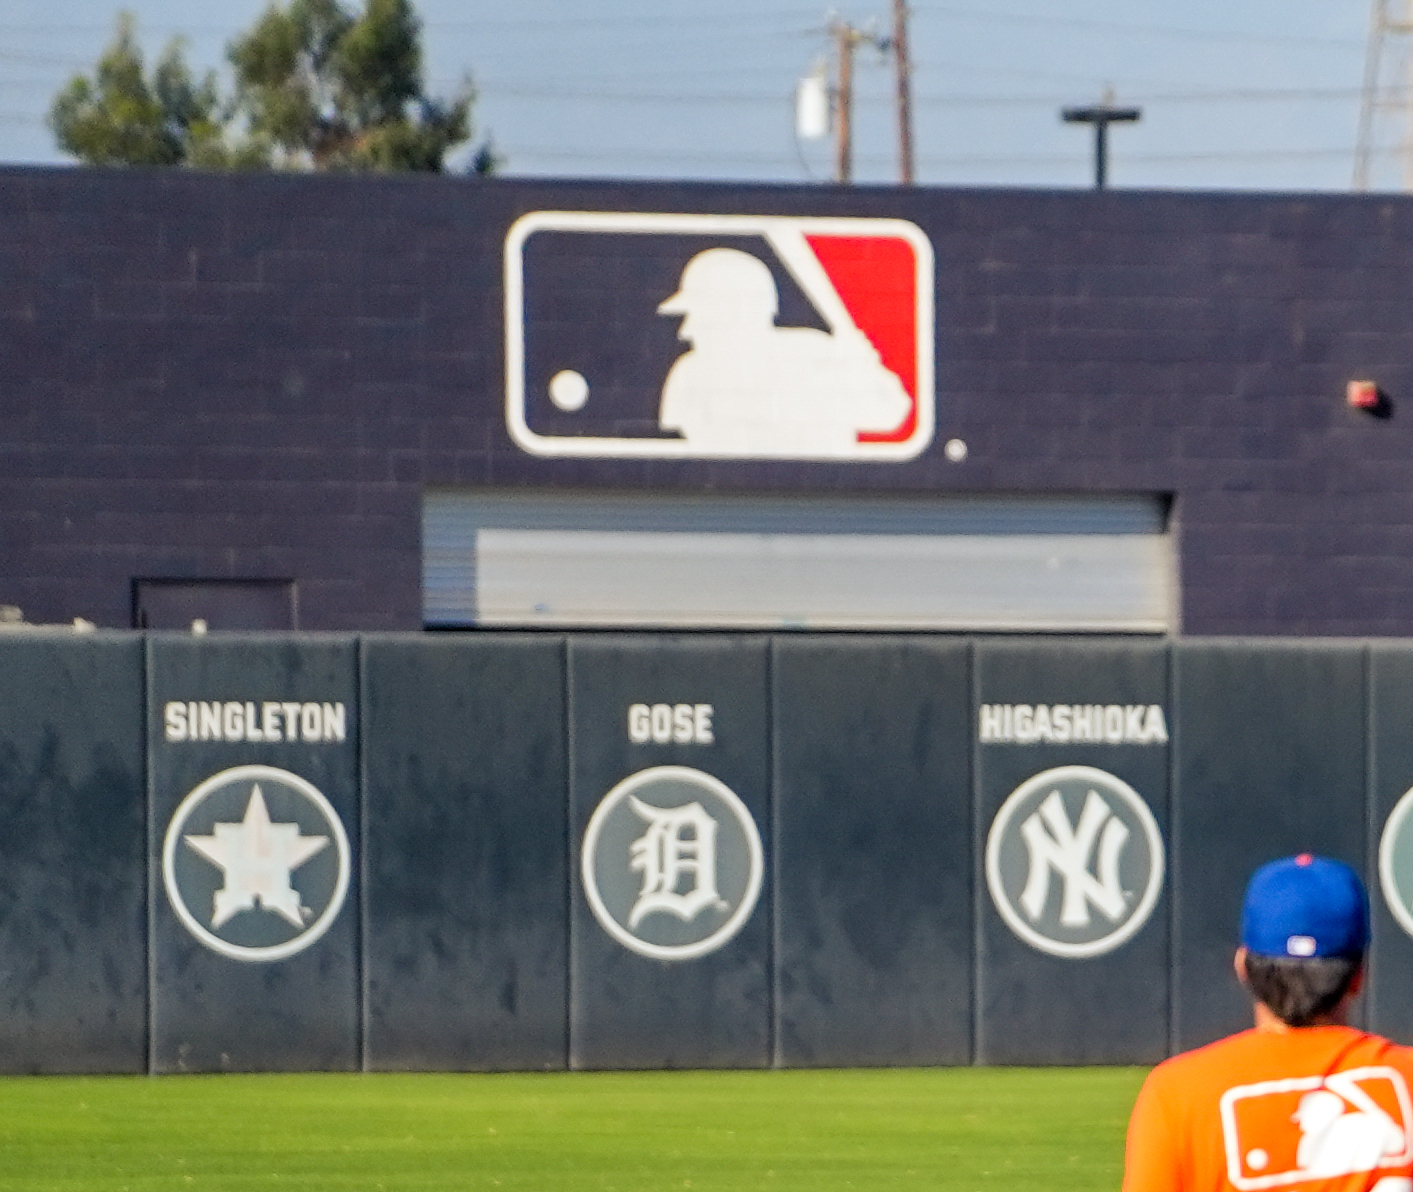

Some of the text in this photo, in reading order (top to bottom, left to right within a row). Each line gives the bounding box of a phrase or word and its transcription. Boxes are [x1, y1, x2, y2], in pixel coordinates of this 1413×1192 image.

[164, 701, 346, 743] SINGLETON
[628, 703, 715, 744] GOSE
[979, 704, 1169, 745] HIGASHIOKA
[1021, 789, 1129, 927] NY
